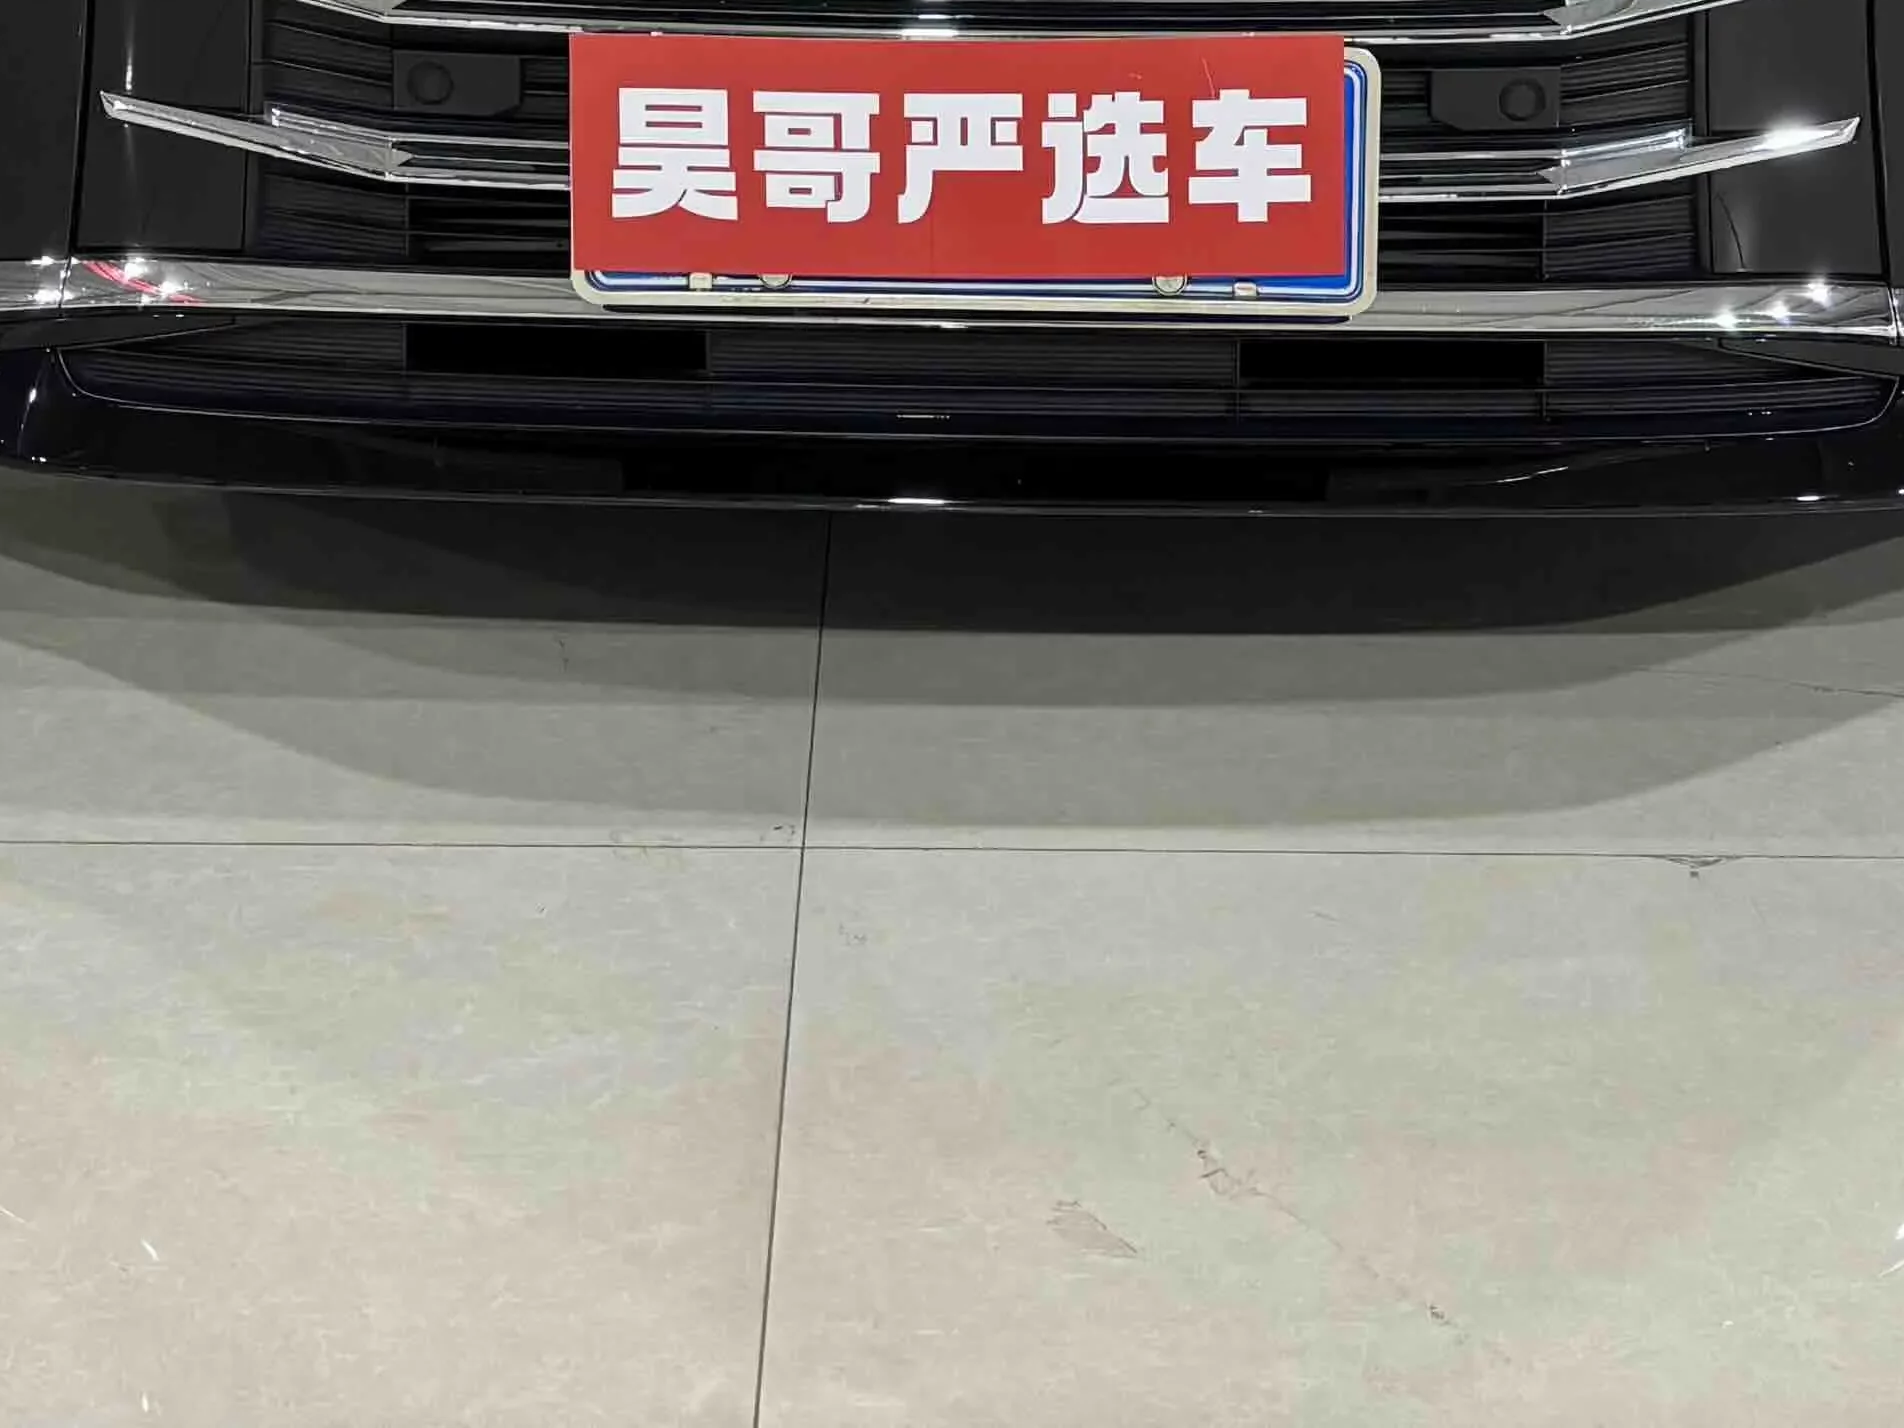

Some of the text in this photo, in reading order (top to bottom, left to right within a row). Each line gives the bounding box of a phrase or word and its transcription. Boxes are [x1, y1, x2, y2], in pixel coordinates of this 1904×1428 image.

[611, 86, 1313, 226] 昊哥严选车
